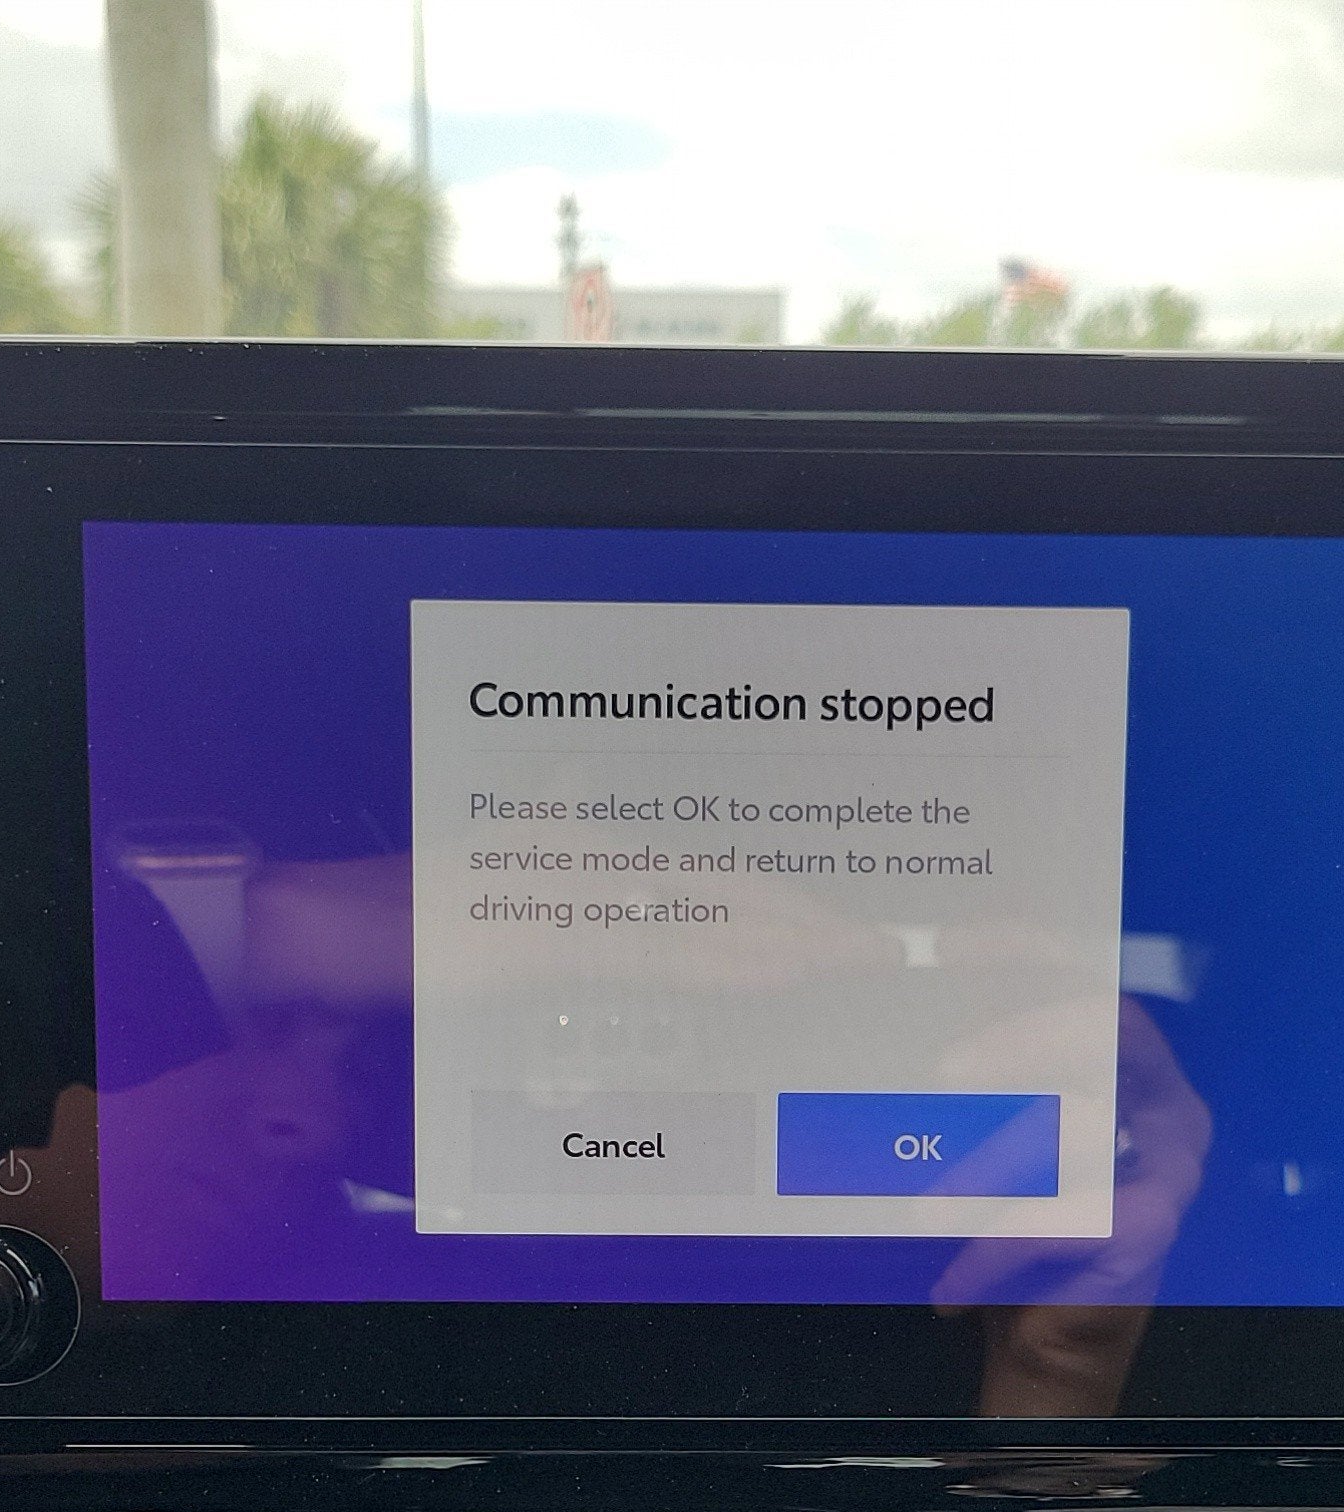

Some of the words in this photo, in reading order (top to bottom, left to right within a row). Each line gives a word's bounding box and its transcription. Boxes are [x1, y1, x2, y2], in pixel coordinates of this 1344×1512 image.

[469, 682, 807, 721] Communication
[819, 687, 995, 731] stopped
[469, 793, 568, 821] Please
[575, 796, 664, 822] select
[673, 796, 720, 823] OK
[729, 800, 760, 823] to
[768, 799, 913, 829] complete
[921, 801, 971, 825] the
[469, 846, 573, 872] service
[581, 846, 670, 873] mode
[678, 847, 736, 874] and
[745, 850, 837, 875] return
[845, 851, 877, 875] to
[885, 849, 993, 876] normal
[469, 895, 575, 928] driving
[583, 898, 729, 928] operation
[562, 1132, 666, 1160] Cancel
[894, 1134, 943, 1161] OK
